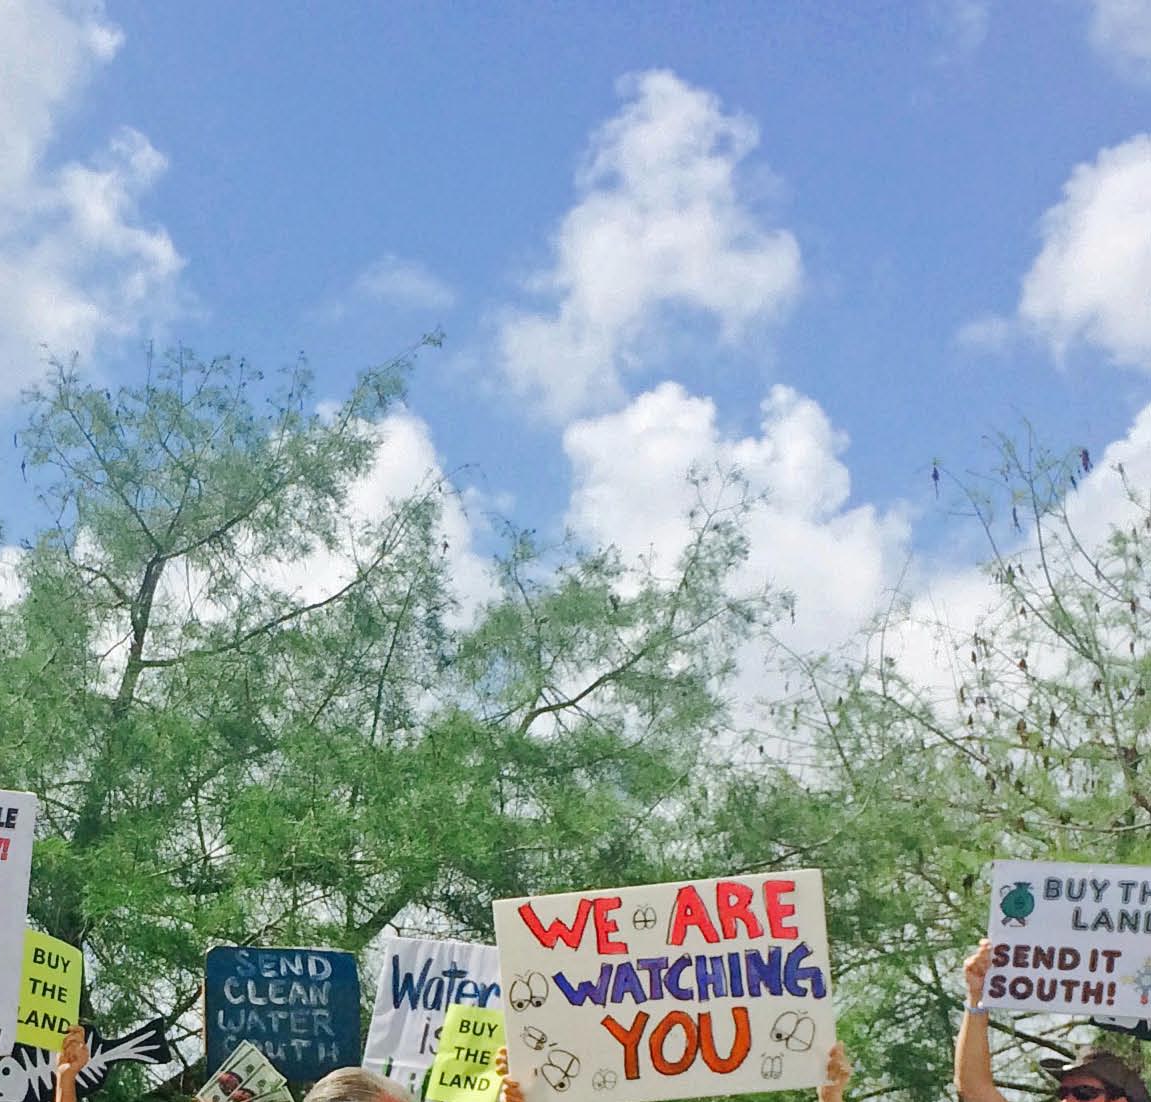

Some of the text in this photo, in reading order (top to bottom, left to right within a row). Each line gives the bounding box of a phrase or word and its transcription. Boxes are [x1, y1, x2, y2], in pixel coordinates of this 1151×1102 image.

[1043, 875, 1151, 905] BUY TH
[517, 880, 800, 955] WE ARE
[33, 948, 71, 973] BUY
[235, 949, 333, 981] SEND
[991, 943, 1123, 974] SEND IT
[392, 954, 501, 1012] Water
[551, 941, 828, 1008] WATCHING
[29, 977, 68, 1003] THE
[223, 976, 332, 1006] CLEAN
[988, 974, 1117, 1007] SOUTH!
[17, 1006, 71, 1034] LAND
[217, 1009, 335, 1037] WATER
[459, 1019, 499, 1038] BUY
[224, 1034, 340, 1063] SUTH
[453, 1046, 491, 1065] THE
[600, 1006, 752, 1081] YOU
[439, 1071, 491, 1092] LAND
